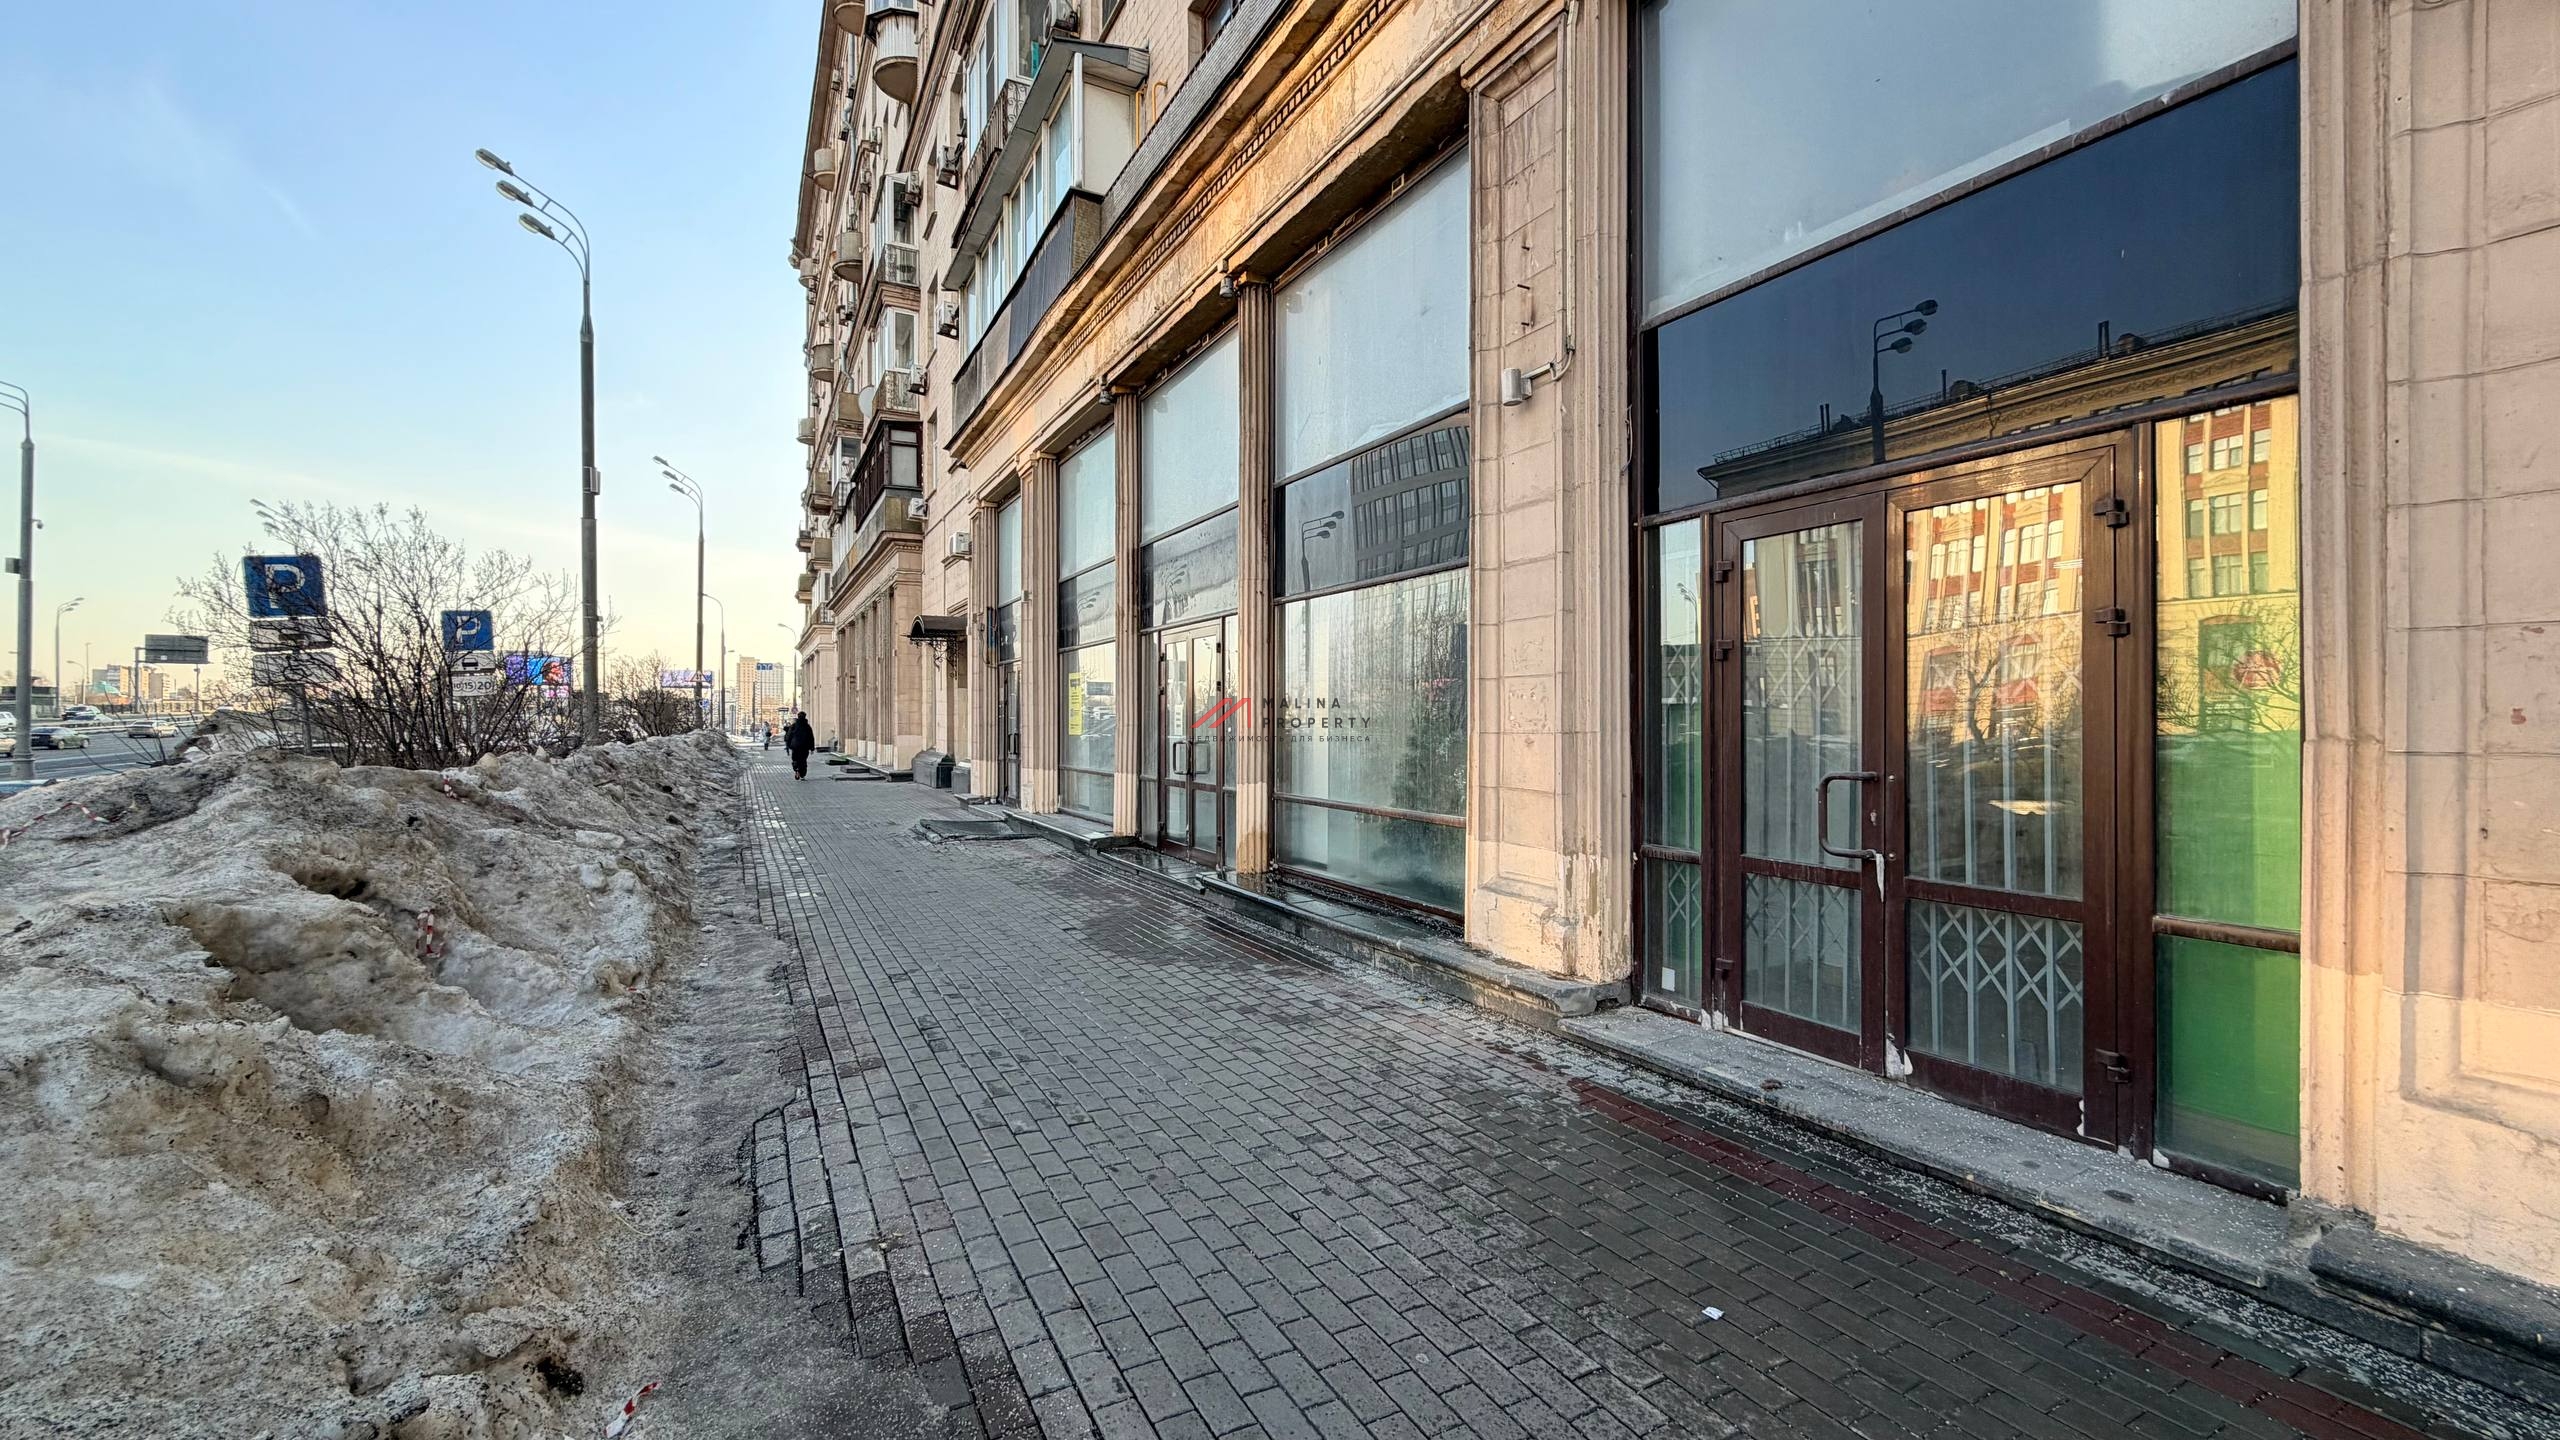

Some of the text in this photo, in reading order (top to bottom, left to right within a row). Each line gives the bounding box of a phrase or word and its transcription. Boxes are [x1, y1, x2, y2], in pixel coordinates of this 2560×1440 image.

[264, 563, 305, 609] P
[457, 615, 482, 646] P
[464, 681, 474, 690] 15
[477, 681, 492, 690] 20
